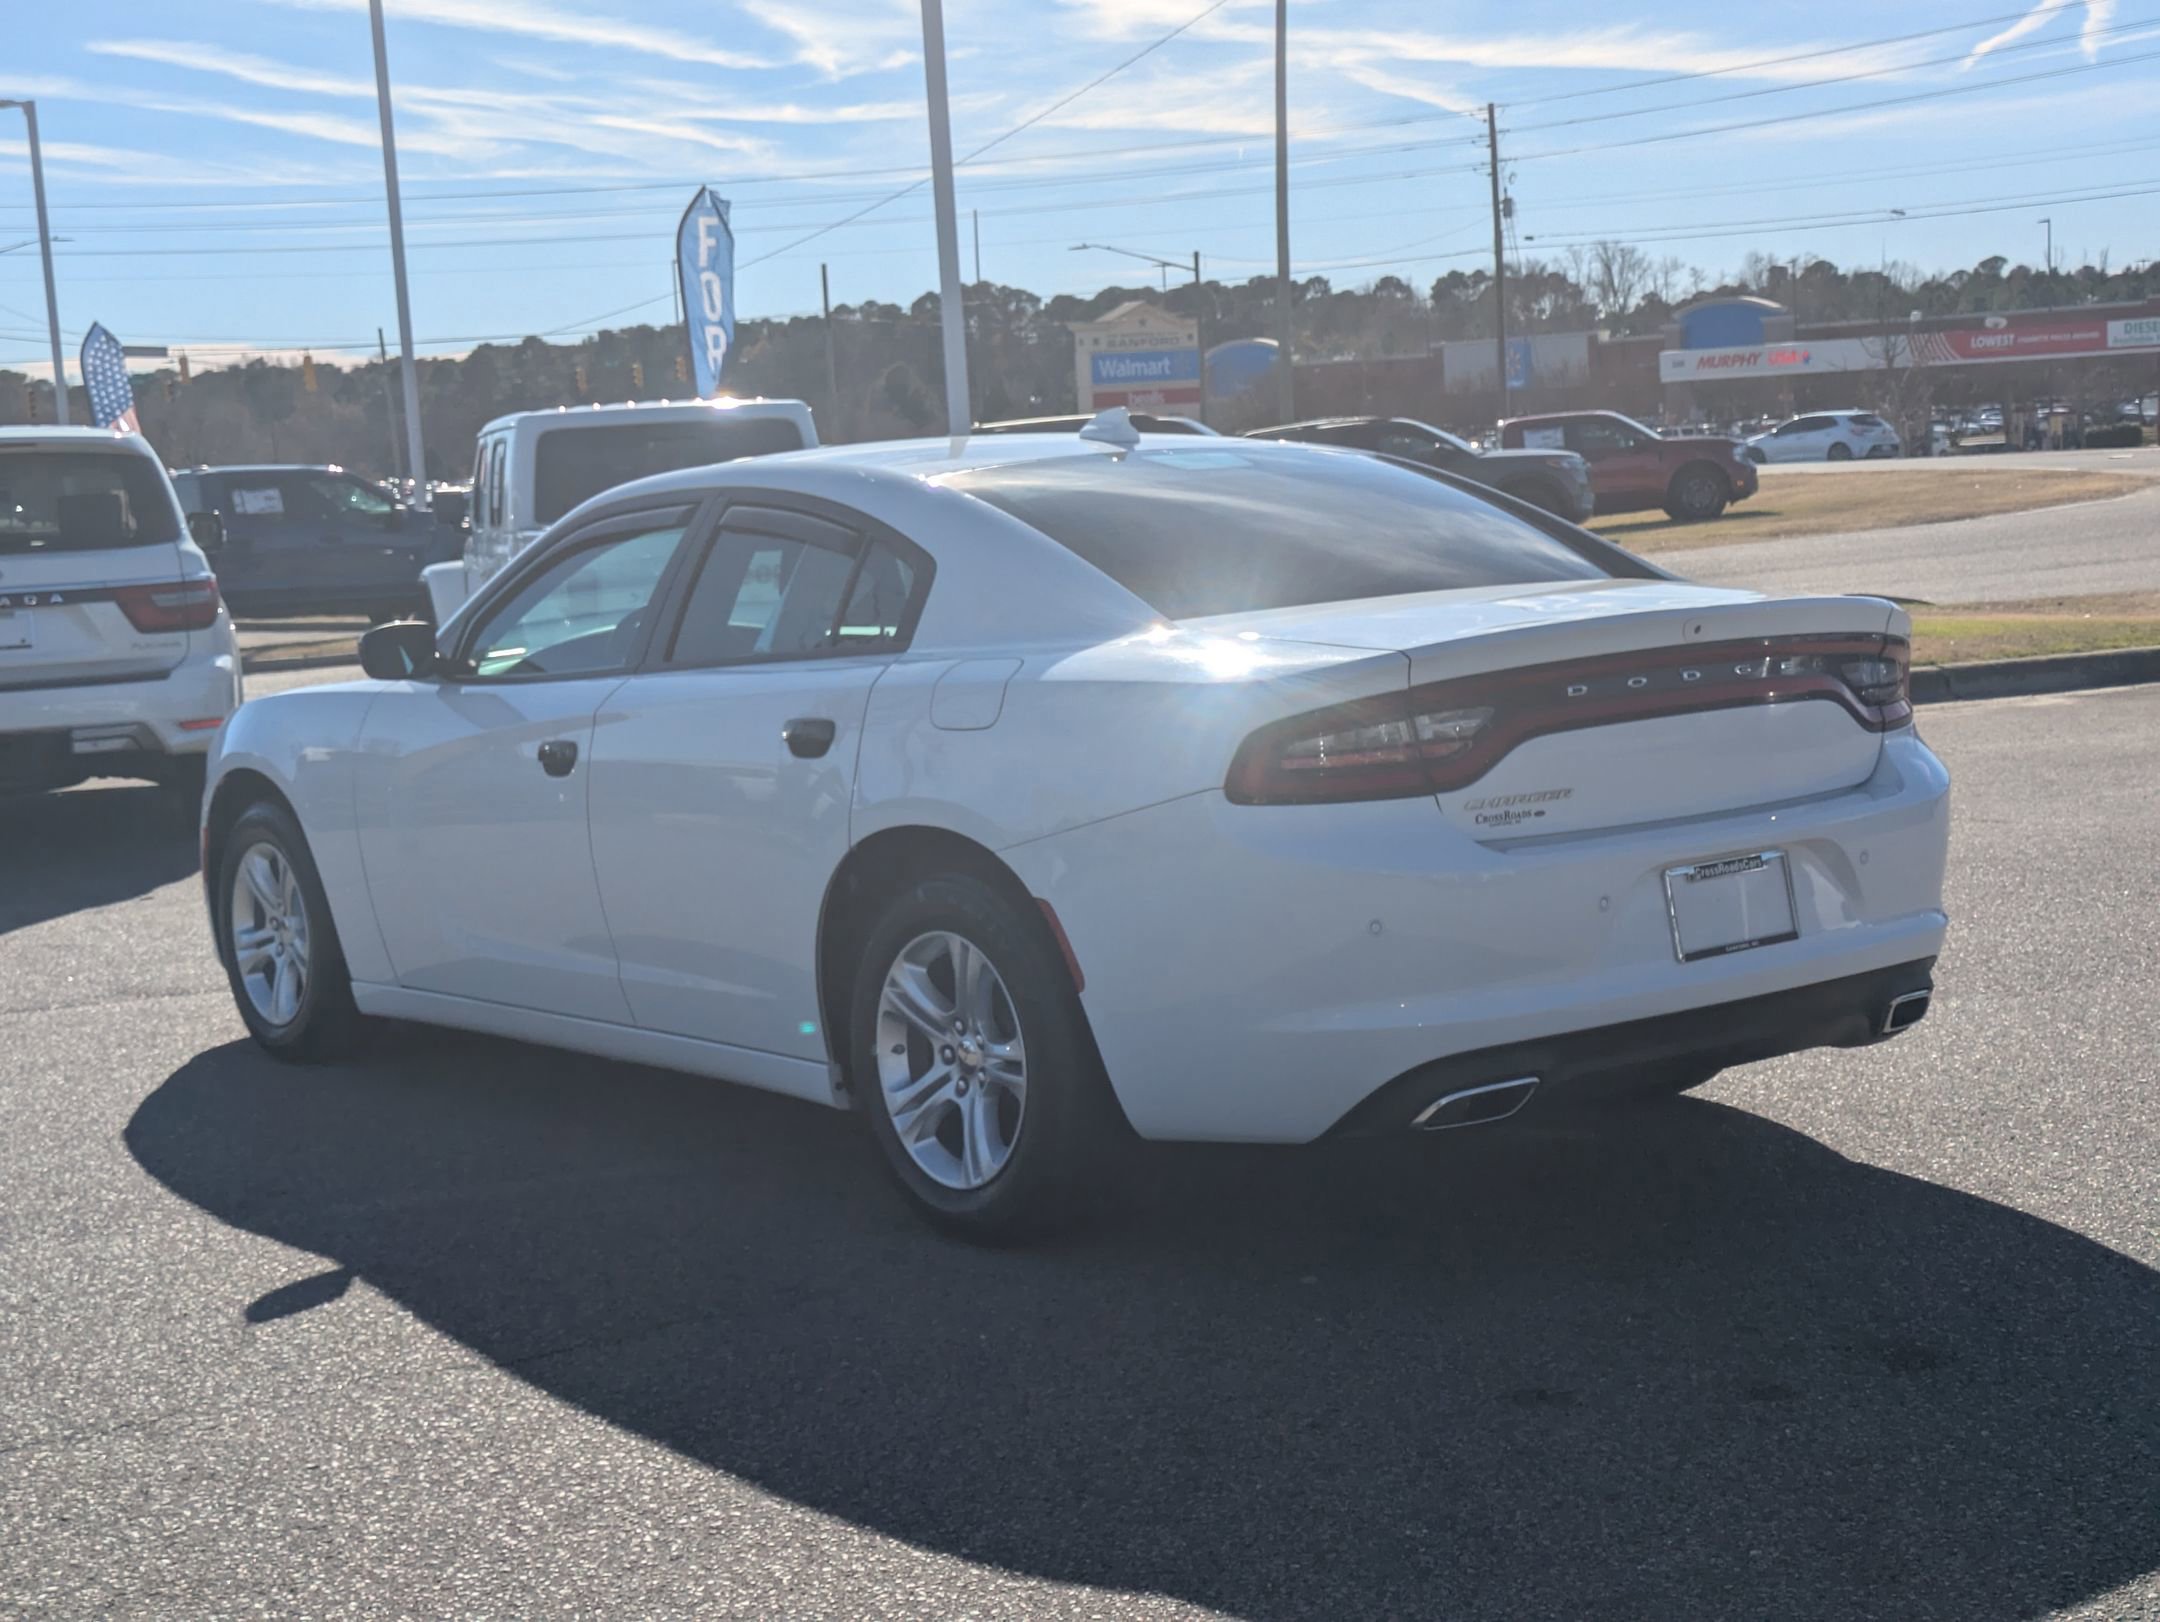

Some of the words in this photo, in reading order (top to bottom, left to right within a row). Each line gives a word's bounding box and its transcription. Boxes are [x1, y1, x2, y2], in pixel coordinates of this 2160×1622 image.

[2124, 321, 2160, 335] DIESE
[1970, 334, 2015, 349] LOWEST
[1099, 357, 1171, 378] Walmart
[1696, 352, 1762, 370] MURPHY
[1767, 350, 1797, 367] USA
[1567, 659, 1794, 696] DODGE
